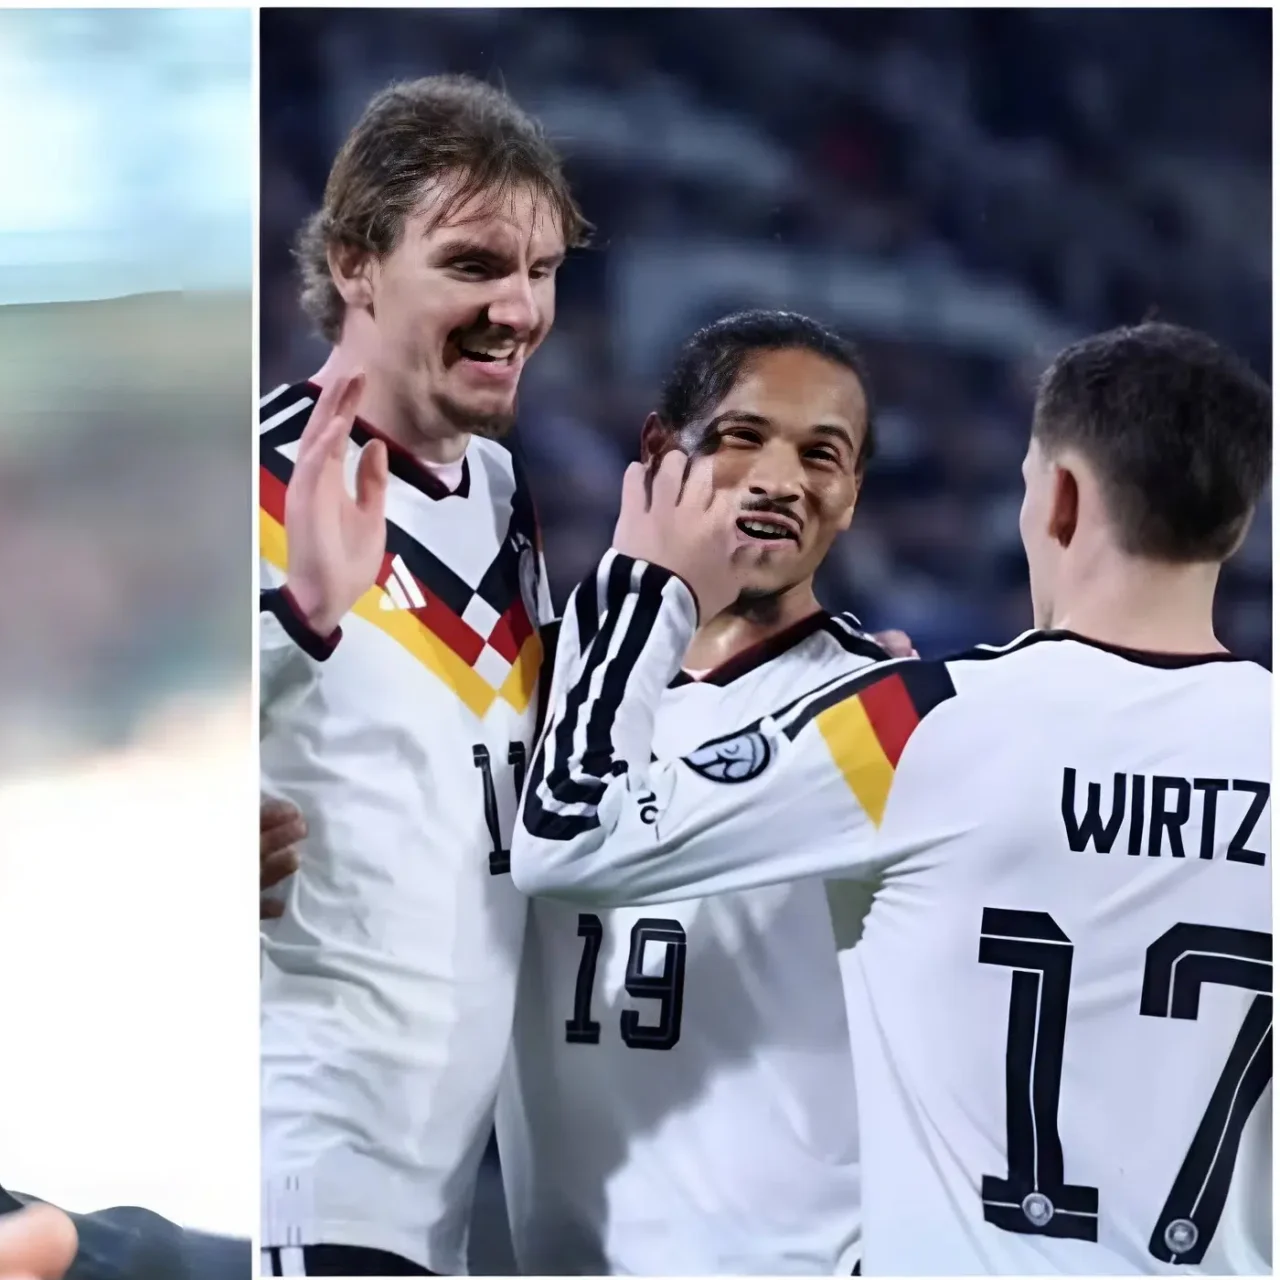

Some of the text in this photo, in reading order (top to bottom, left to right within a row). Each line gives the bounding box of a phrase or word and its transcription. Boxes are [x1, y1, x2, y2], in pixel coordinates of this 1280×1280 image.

[1061, 767, 1271, 866] WIRTZ
[566, 913, 687, 1050] 19
[978, 907, 1272, 1265] 17
